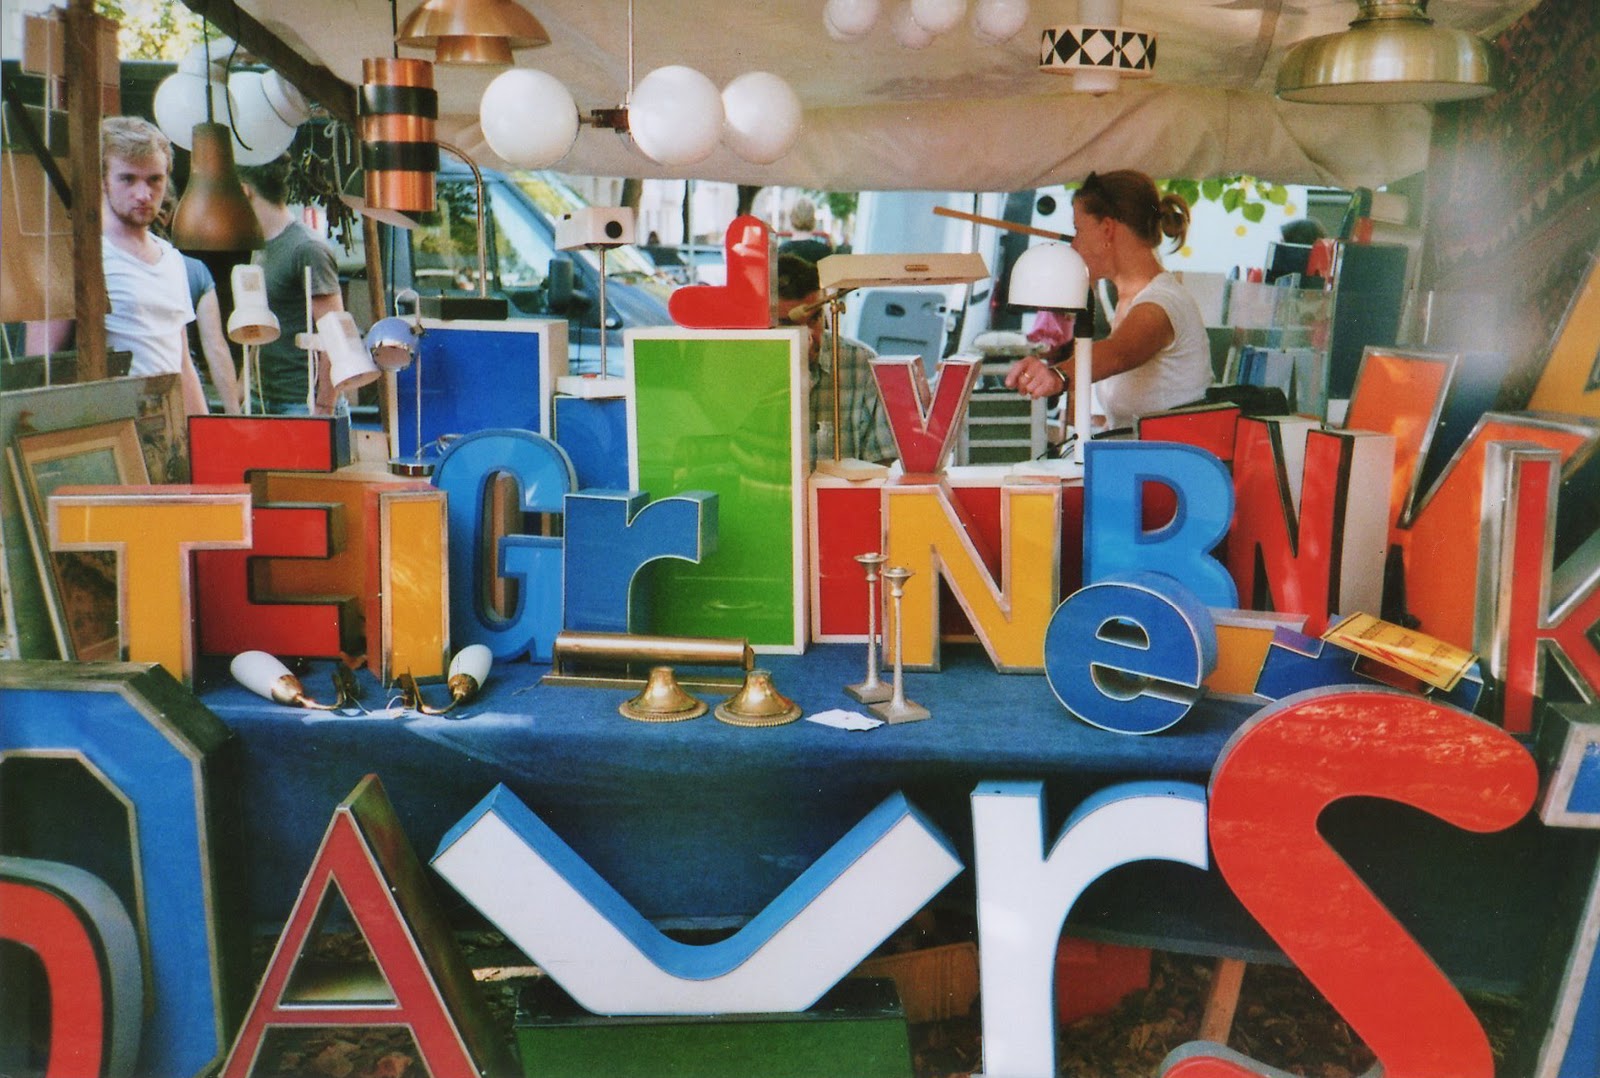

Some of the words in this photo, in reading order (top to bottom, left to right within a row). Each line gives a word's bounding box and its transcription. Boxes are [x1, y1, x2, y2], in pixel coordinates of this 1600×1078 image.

[48, 484, 252, 692] T
[431, 428, 577, 663] G
[881, 476, 1062, 674] N
[1083, 440, 1238, 611] B
[222, 790, 487, 1078] A
